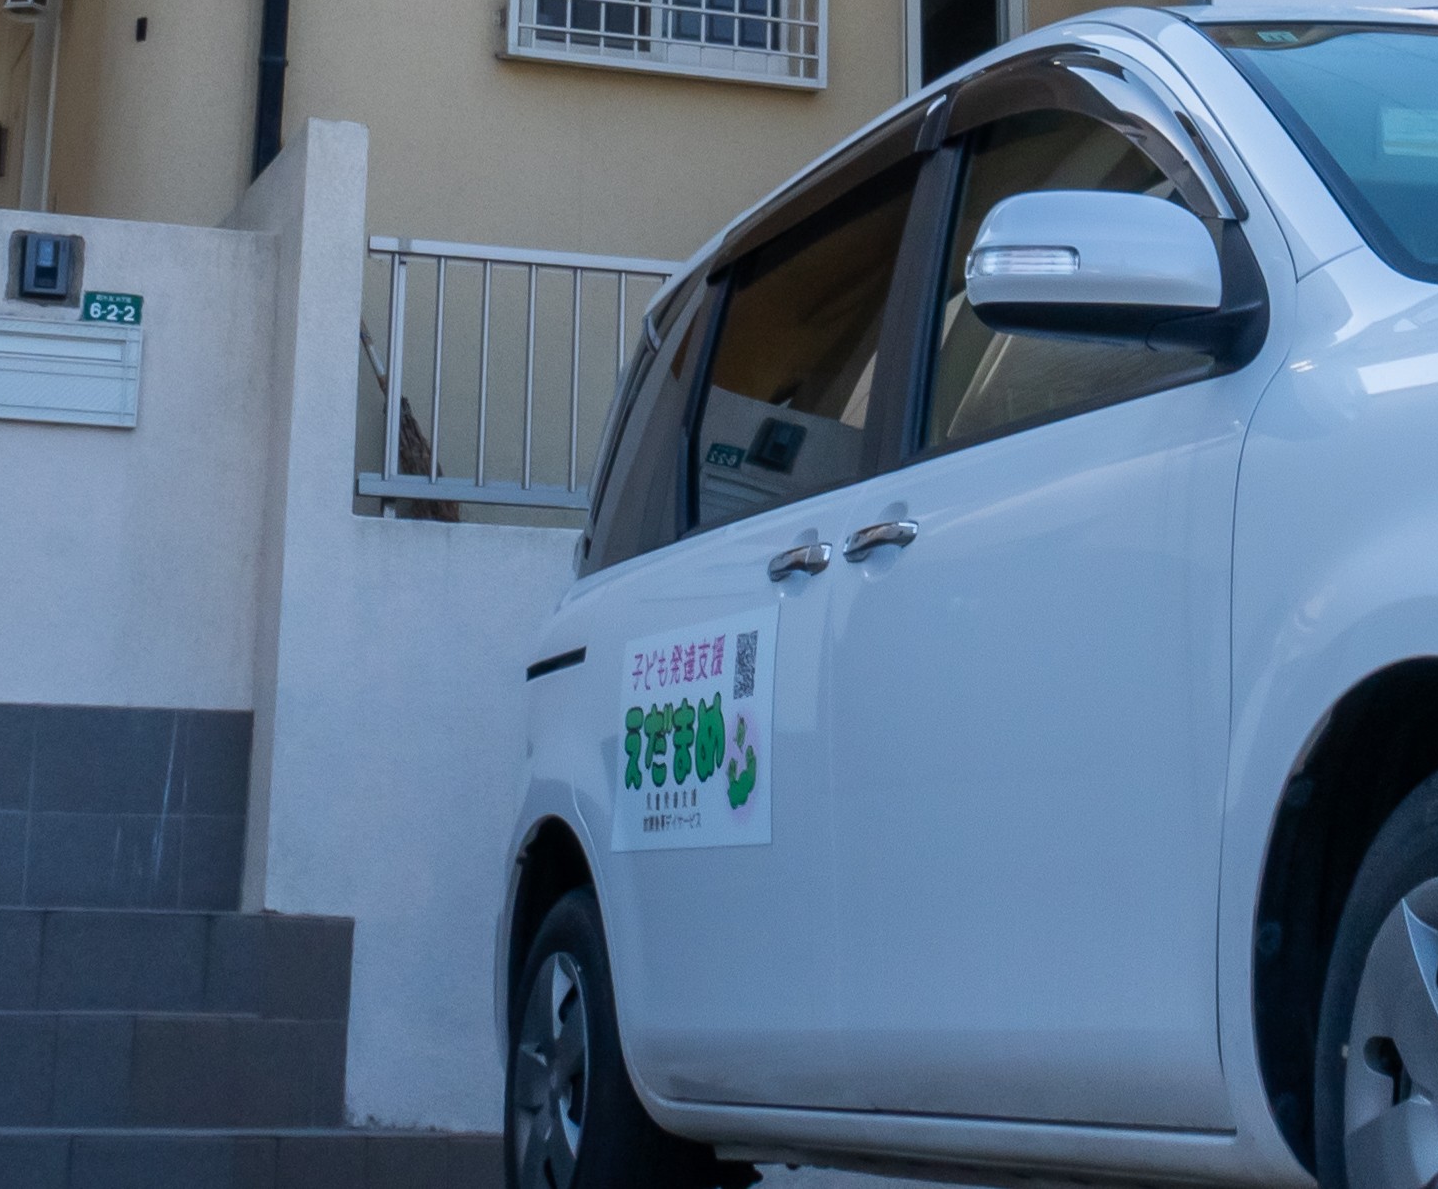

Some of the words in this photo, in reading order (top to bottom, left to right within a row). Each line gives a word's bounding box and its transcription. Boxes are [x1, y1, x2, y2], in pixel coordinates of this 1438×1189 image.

[90, 303, 135, 321] 6-2-2
[632, 634, 725, 690] 子ども発達支援
[625, 692, 726, 790] えだまめ
